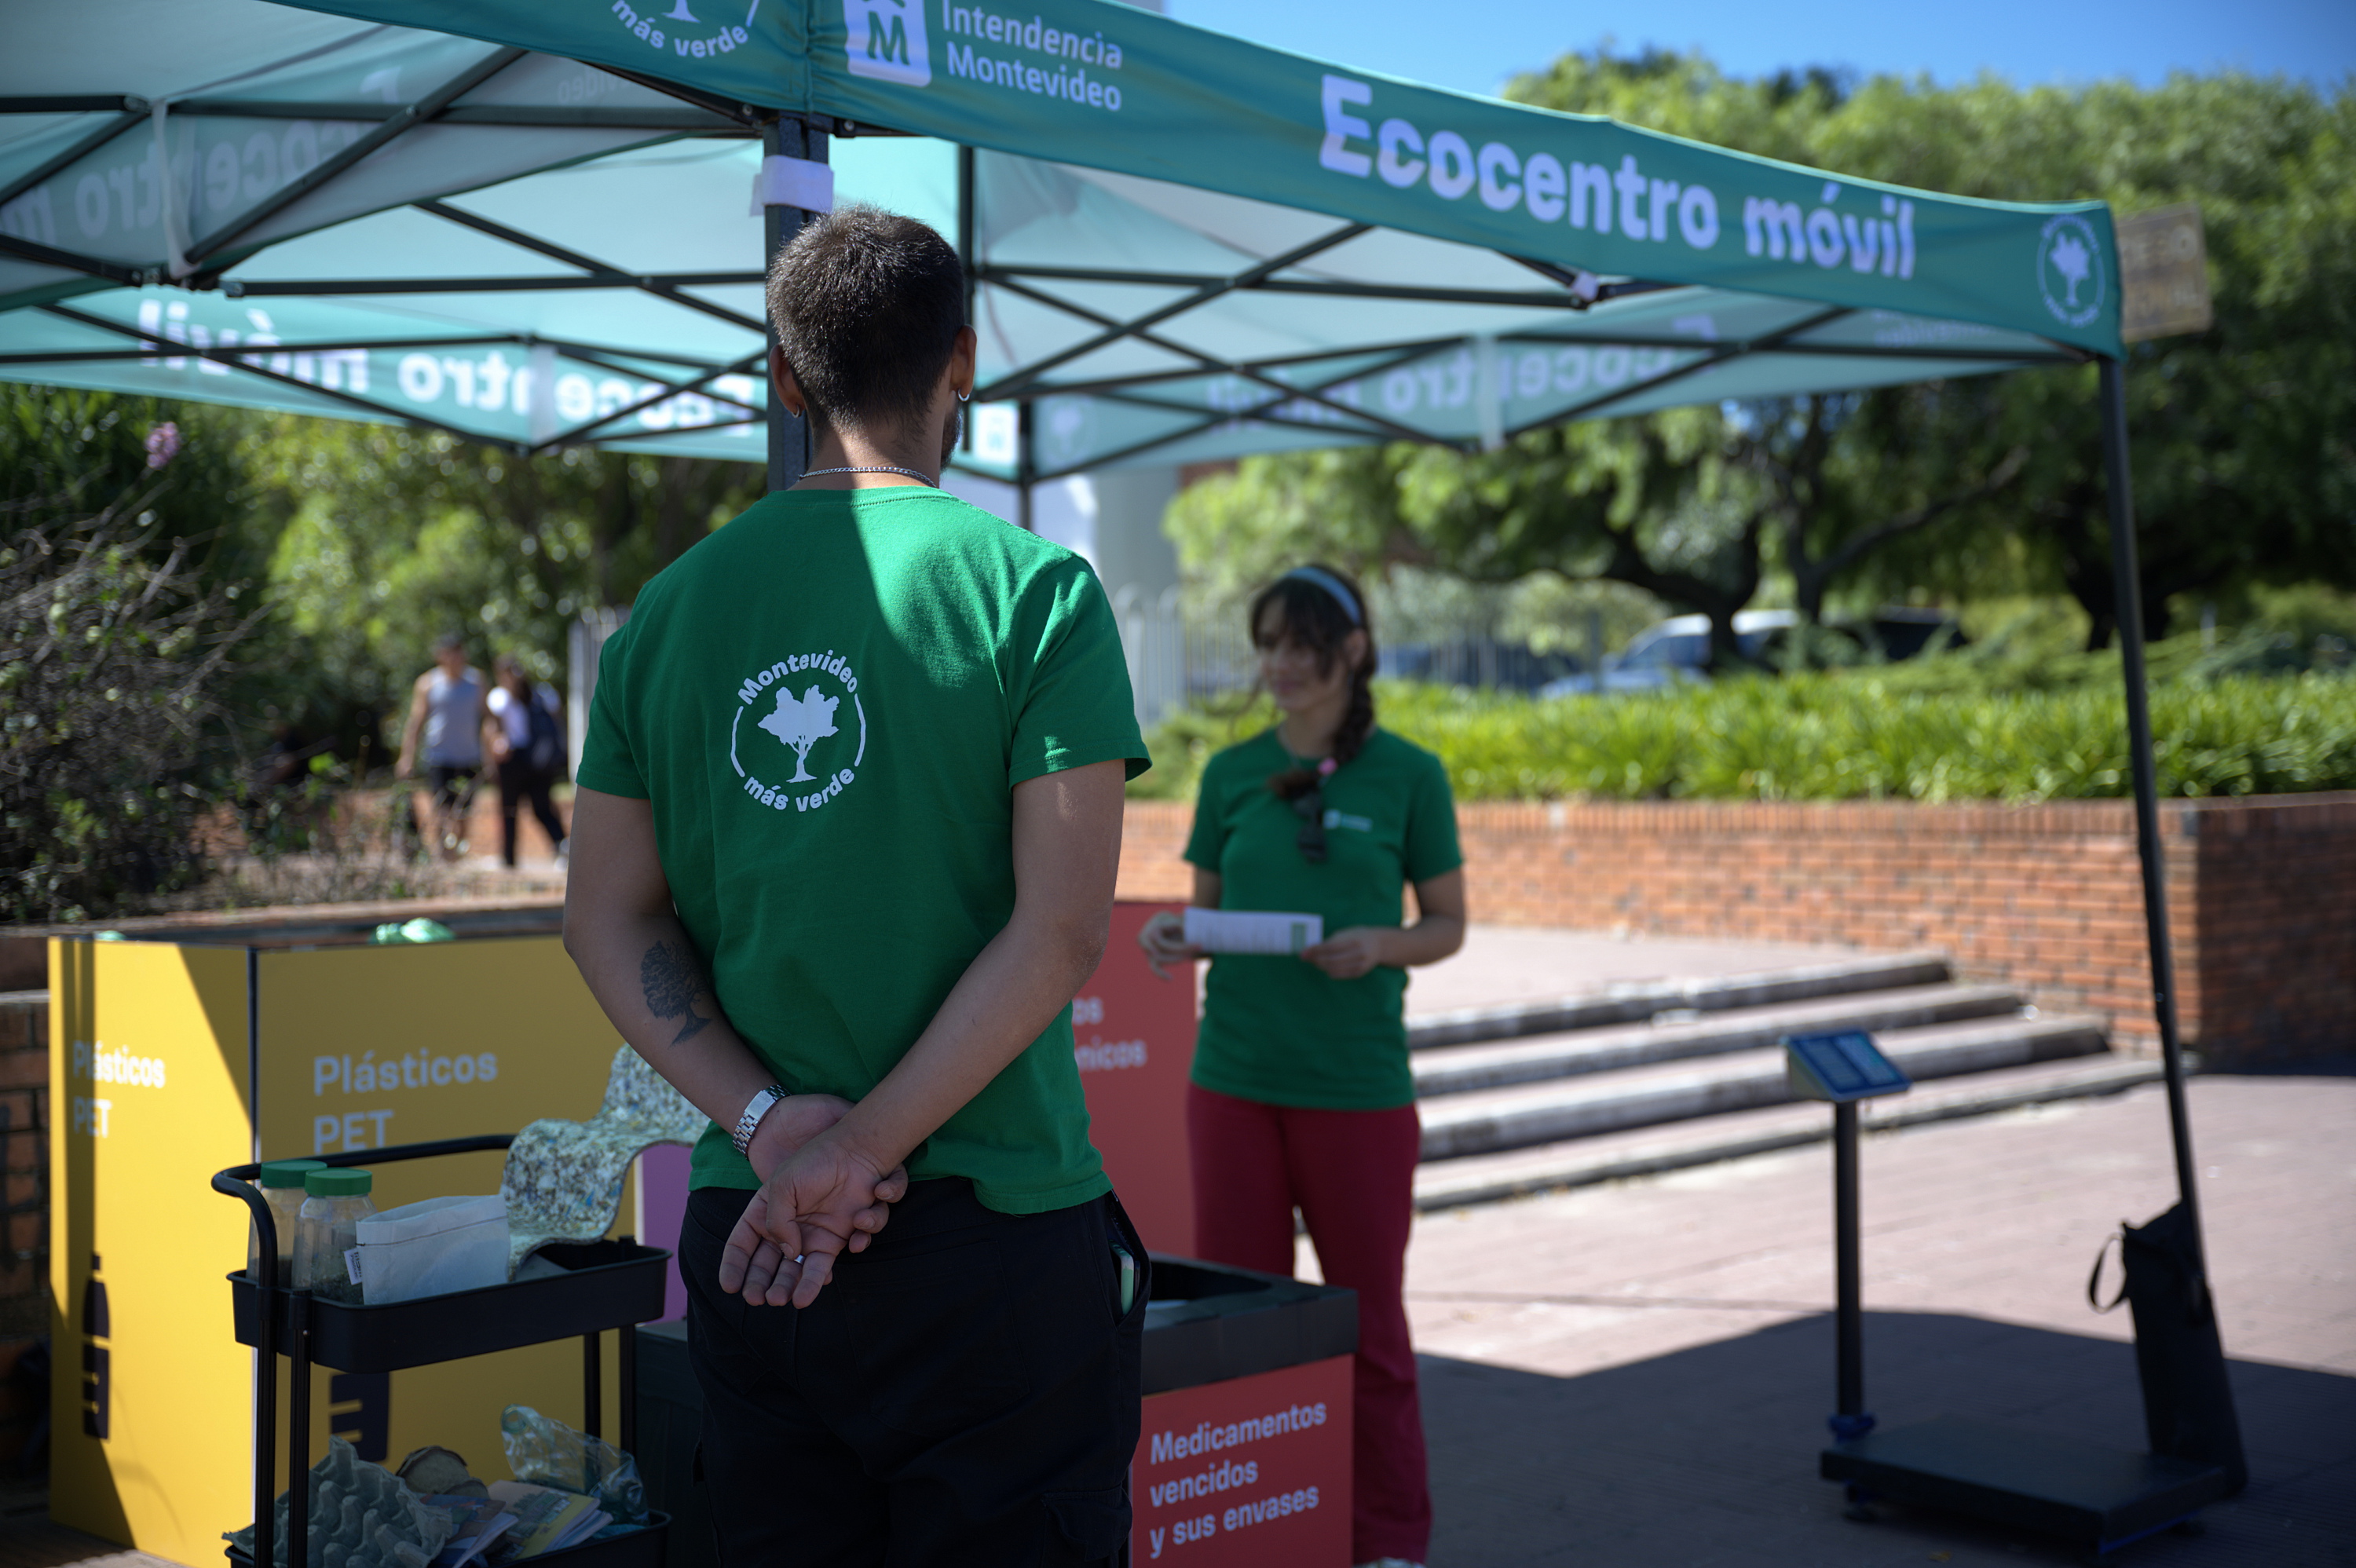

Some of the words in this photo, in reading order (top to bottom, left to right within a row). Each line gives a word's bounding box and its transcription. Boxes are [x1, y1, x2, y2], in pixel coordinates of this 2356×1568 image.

[611, 0, 665, 49] más
[674, 25, 748, 58] verde
[943, 2, 1123, 69] Intendencia
[947, 41, 1122, 111] Montevideo
[1319, 73, 1721, 250] Ecocentro
[1742, 180, 1915, 280] móvil
[737, 649, 858, 705] Montevideo
[744, 777, 788, 810] más
[796, 768, 855, 812] verde
[72, 1040, 166, 1089] Plásticos
[313, 1046, 499, 1096] Plásticos
[72, 1095, 113, 1139] PET
[313, 1109, 394, 1156] PET
[1150, 1402, 1327, 1465] Medicamentos
[1150, 1459, 1259, 1508] vencidos
[1150, 1526, 1165, 1559] y
[1173, 1513, 1216, 1545] sus
[1223, 1486, 1320, 1531] envases
